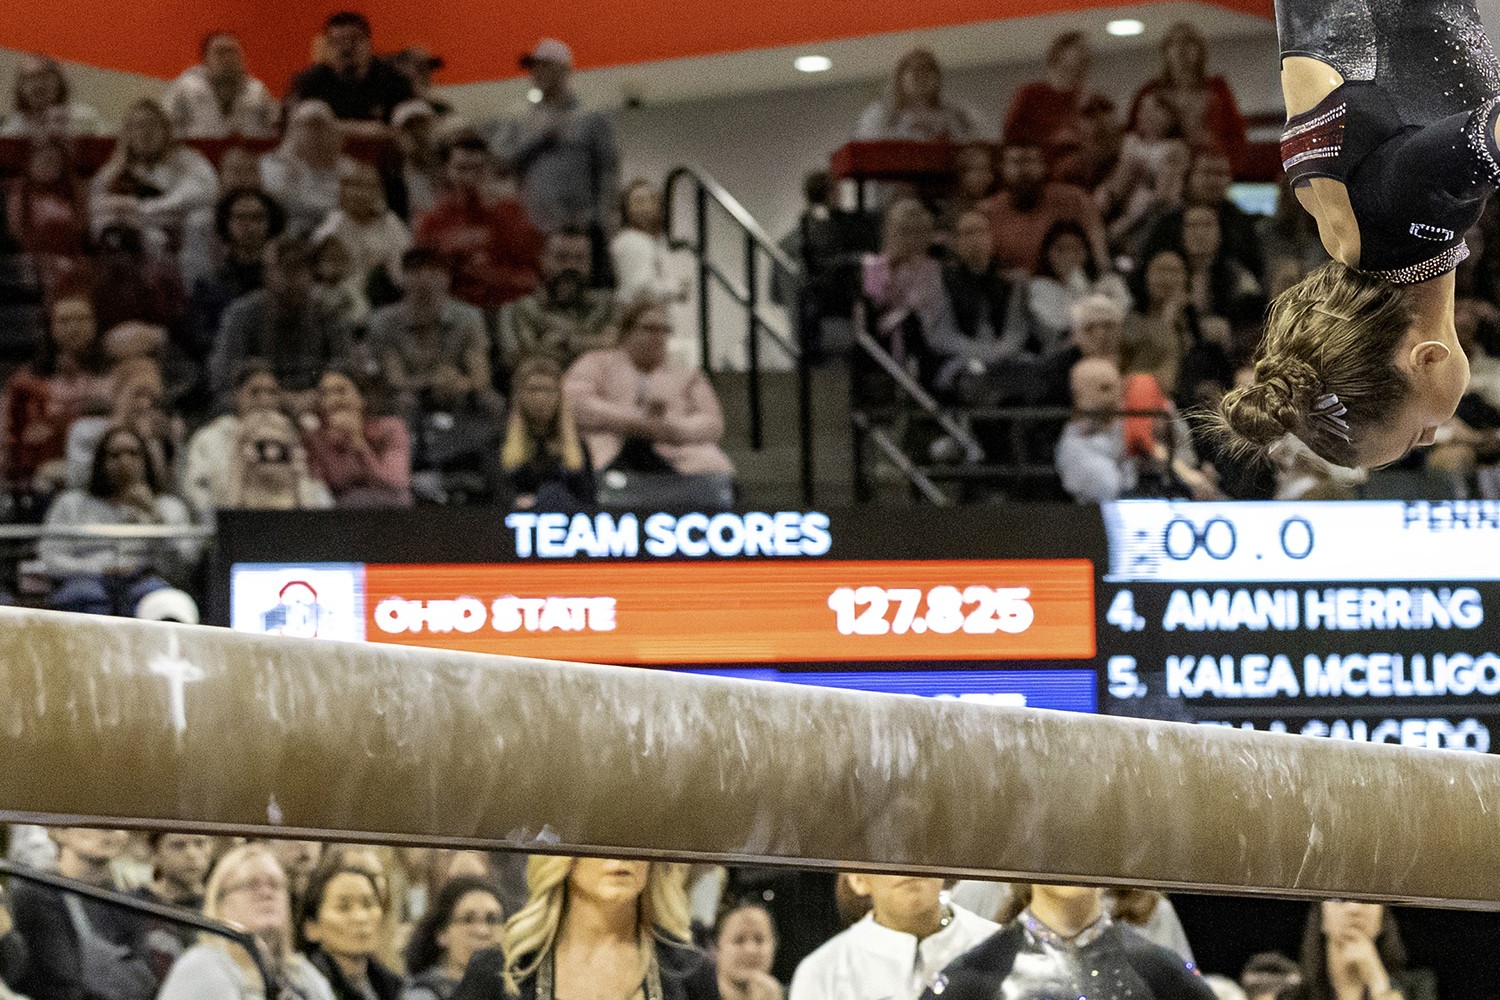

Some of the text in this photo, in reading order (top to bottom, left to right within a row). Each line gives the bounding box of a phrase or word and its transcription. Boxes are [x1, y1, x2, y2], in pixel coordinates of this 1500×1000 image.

[506, 511, 832, 557] TEAM SCORES
[374, 594, 617, 633] OHIO STATE
[827, 585, 1034, 635] 127.825
[1106, 588, 1484, 631] 4. AMANI HERRING
[1107, 655, 1148, 699] 5.
[1165, 653, 1300, 698] KALEA
